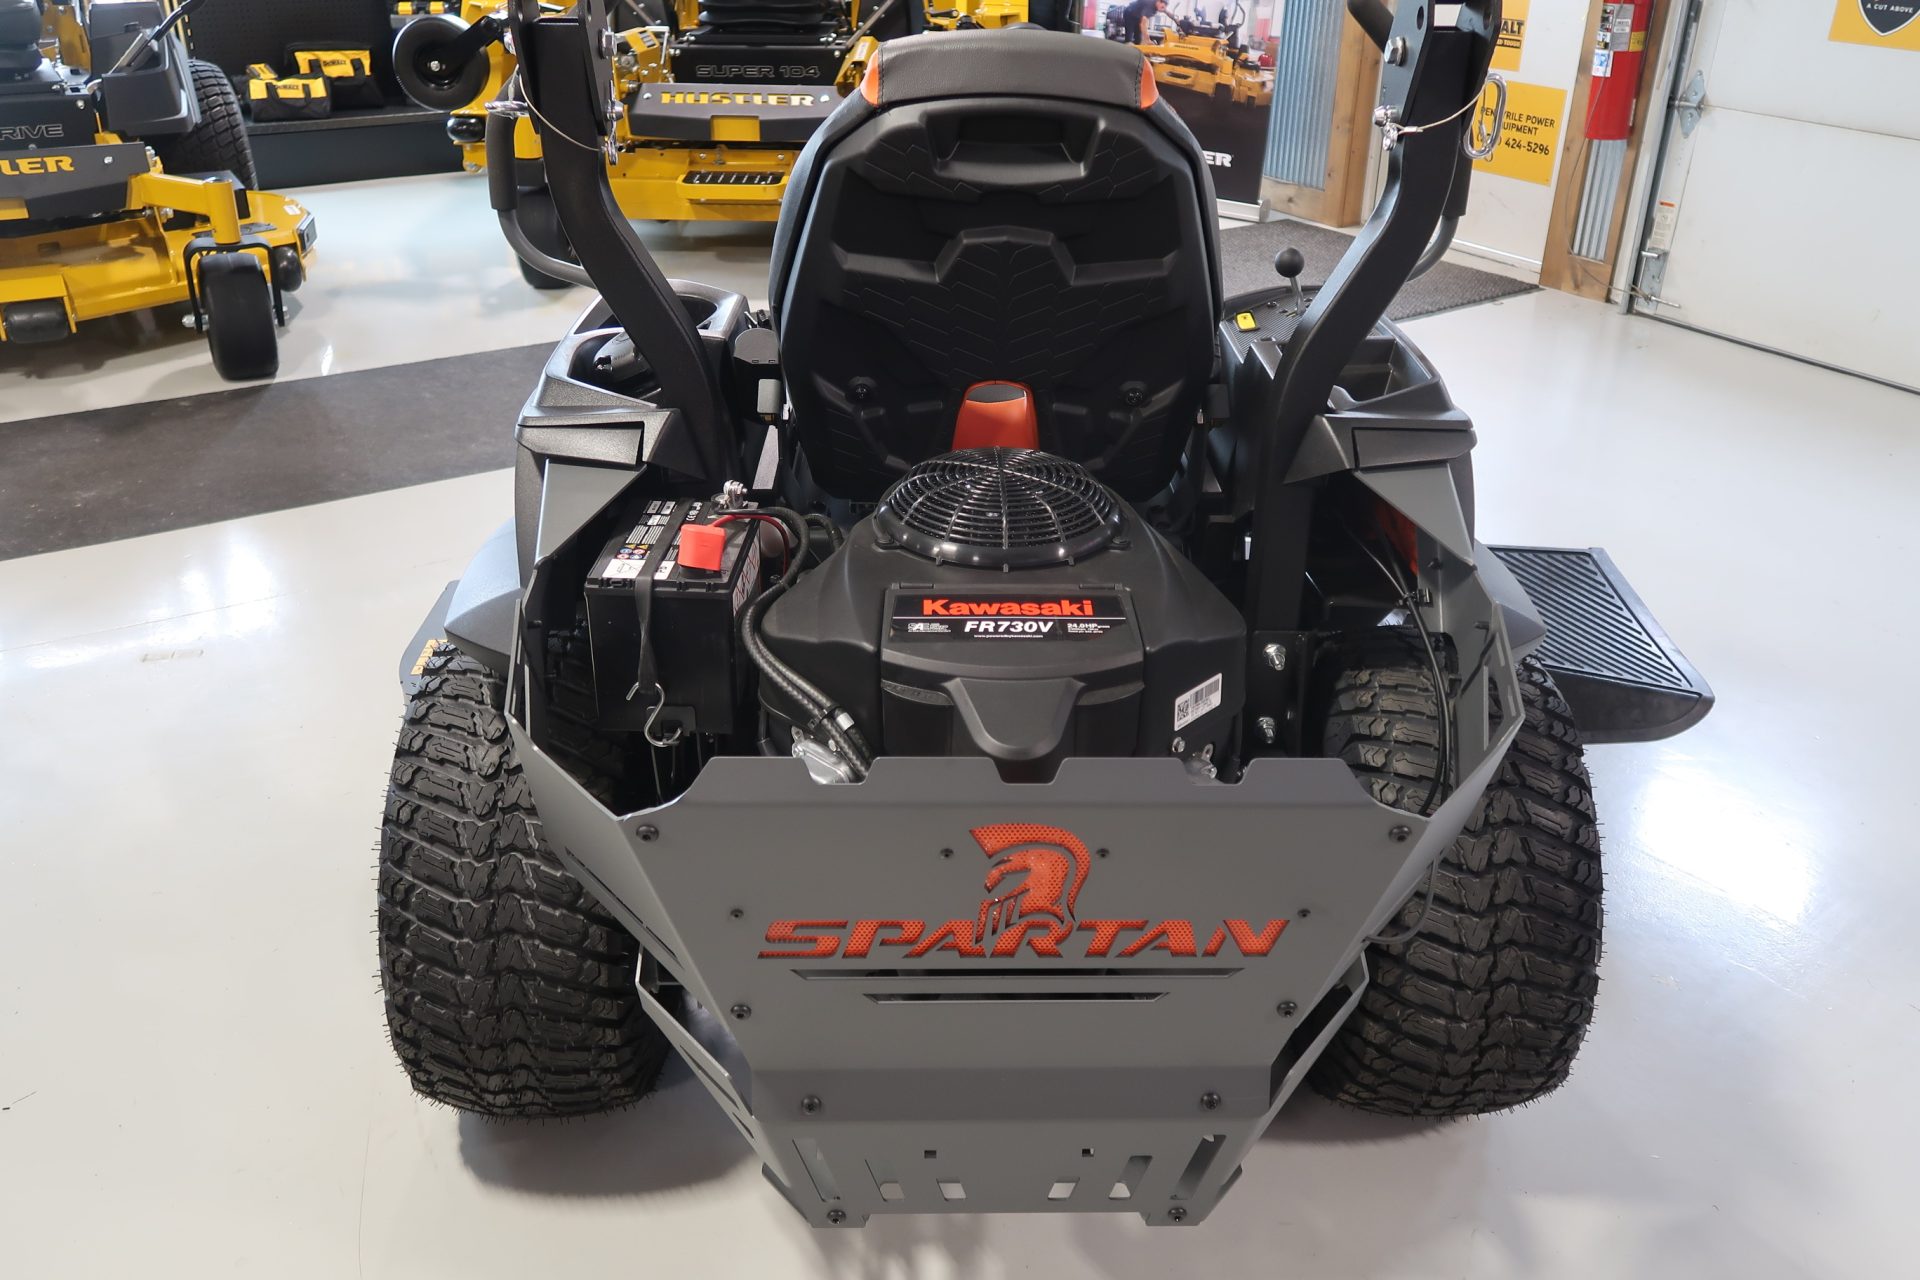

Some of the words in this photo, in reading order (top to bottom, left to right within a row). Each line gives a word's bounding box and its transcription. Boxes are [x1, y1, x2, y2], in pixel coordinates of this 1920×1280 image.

[696, 64, 775, 78] SUPER
[779, 65, 821, 78] 104
[660, 91, 815, 106] HUSTLER
[1525, 115, 1556, 128] POWER
[1505, 138, 1549, 155] 424-5296
[923, 599, 1093, 616] Kawasaki
[964, 620, 1054, 633] FR730V
[757, 919, 1291, 959] SPARTAN
